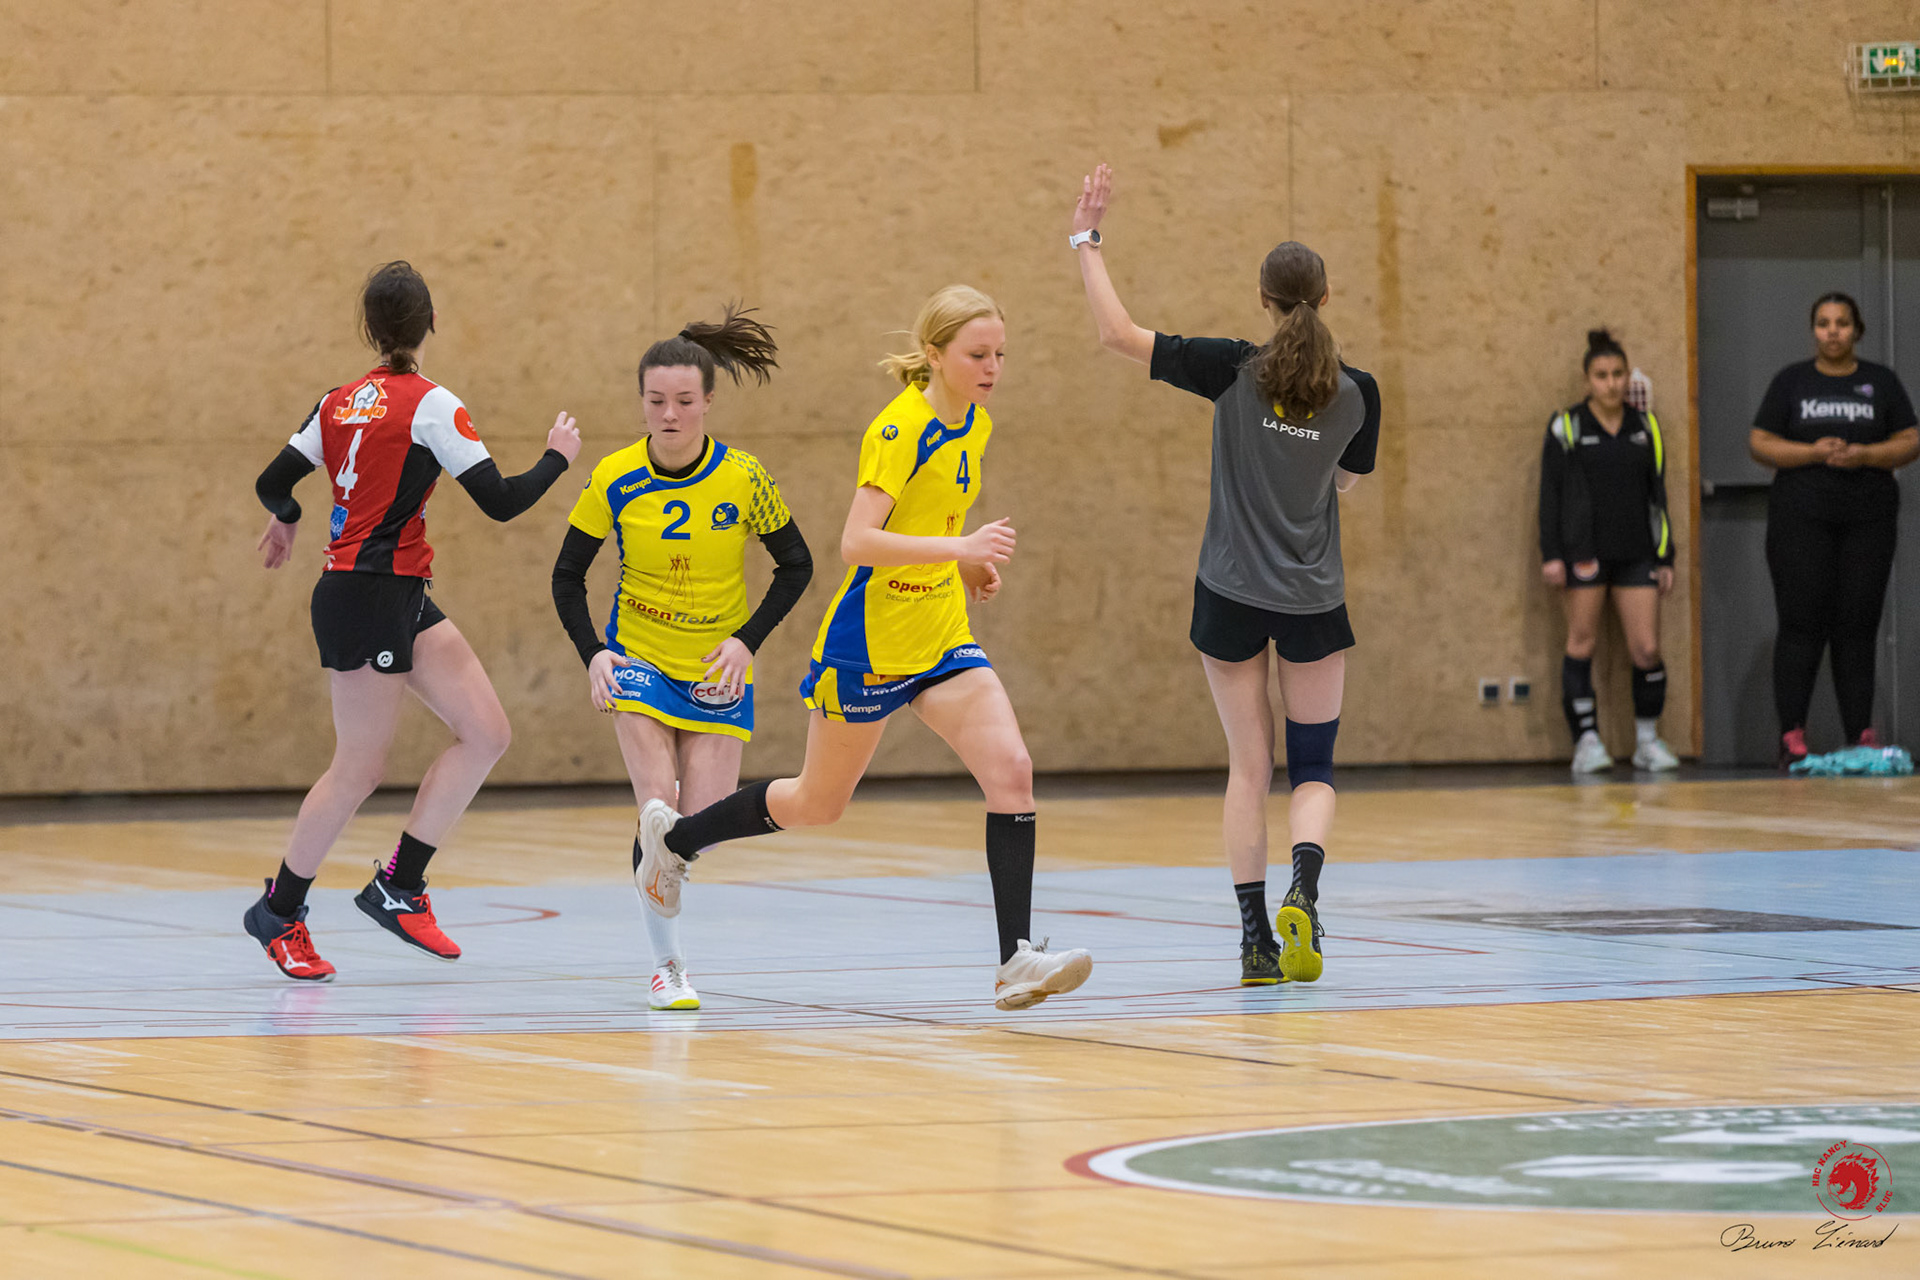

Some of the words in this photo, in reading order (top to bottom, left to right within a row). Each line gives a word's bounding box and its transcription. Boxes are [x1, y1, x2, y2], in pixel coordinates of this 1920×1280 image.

[1801, 399, 1874, 422] Kempa
[1262, 418, 1278, 430] LA
[1279, 423, 1320, 441] POSTE
[335, 429, 363, 500] 4
[956, 450, 970, 493] 4
[619, 477, 652, 495] Kempa
[661, 500, 691, 540] 2
[843, 704, 881, 714] Kempa
